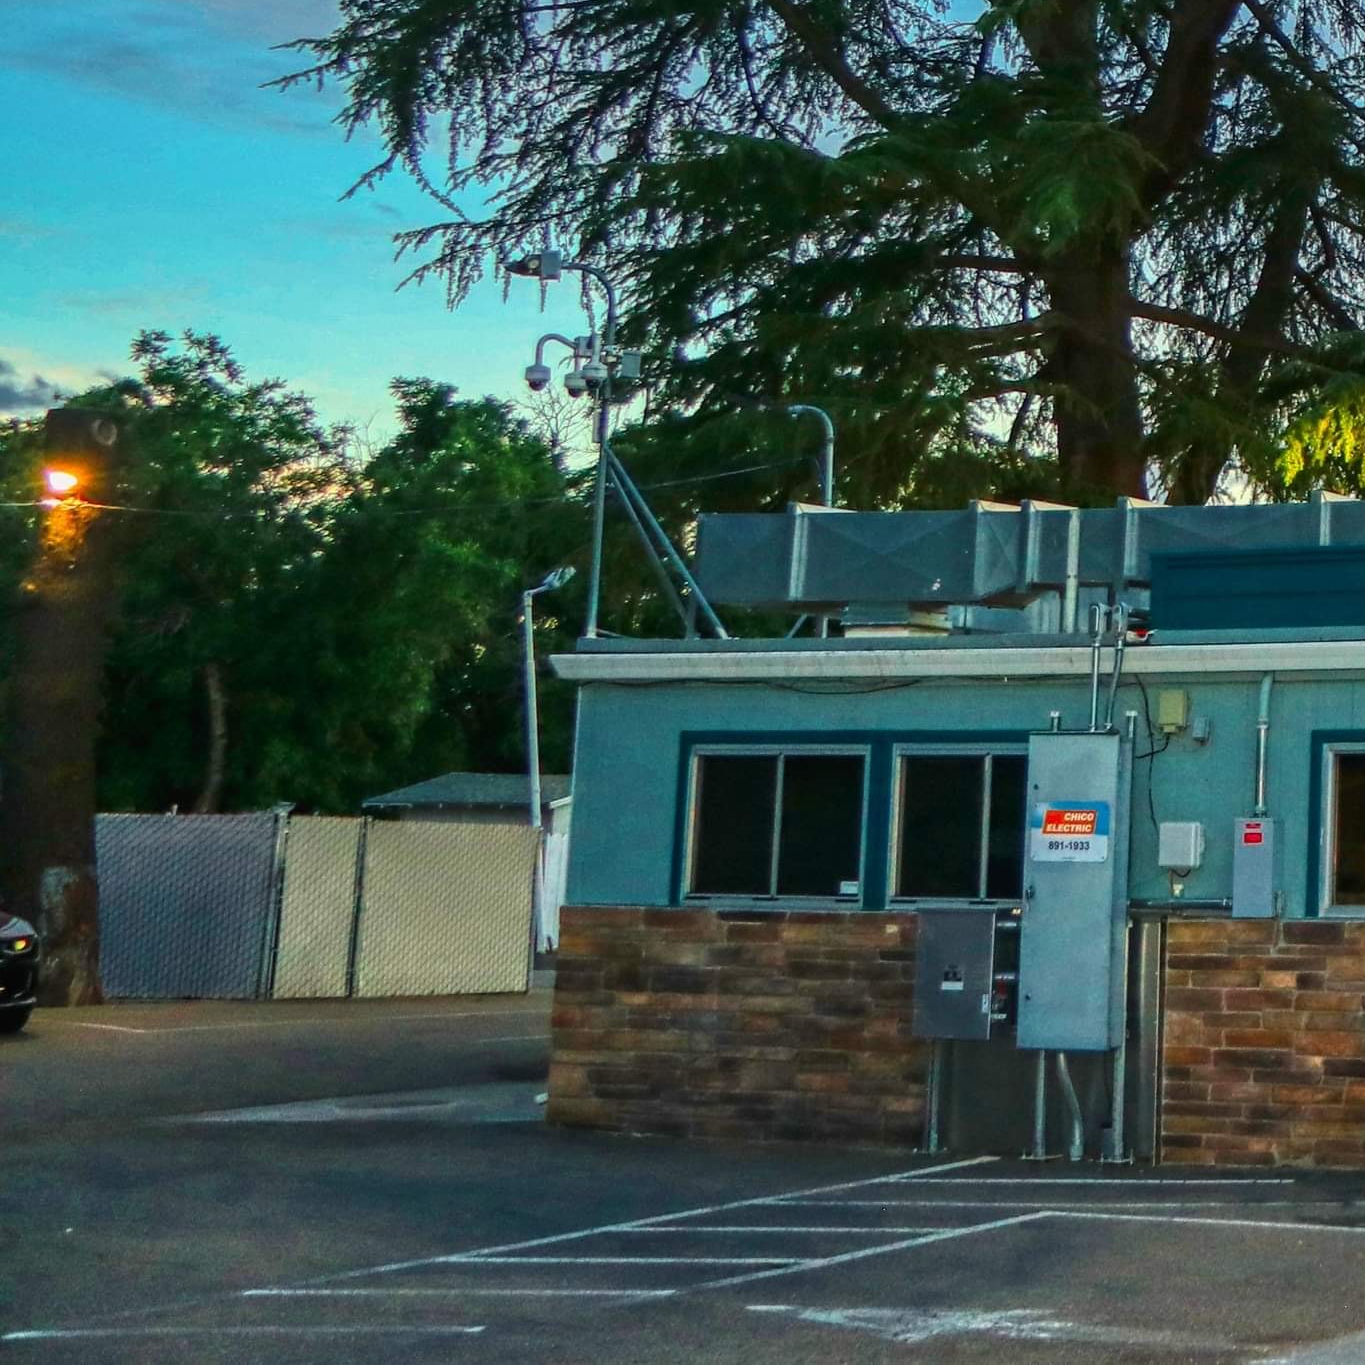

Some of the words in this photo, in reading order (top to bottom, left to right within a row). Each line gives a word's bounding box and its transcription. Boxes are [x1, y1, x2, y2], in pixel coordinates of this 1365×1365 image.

[1063, 812, 1095, 822] CHICO
[1046, 823, 1093, 833] ELECTRIC
[1048, 840, 1090, 851] 891-1933
